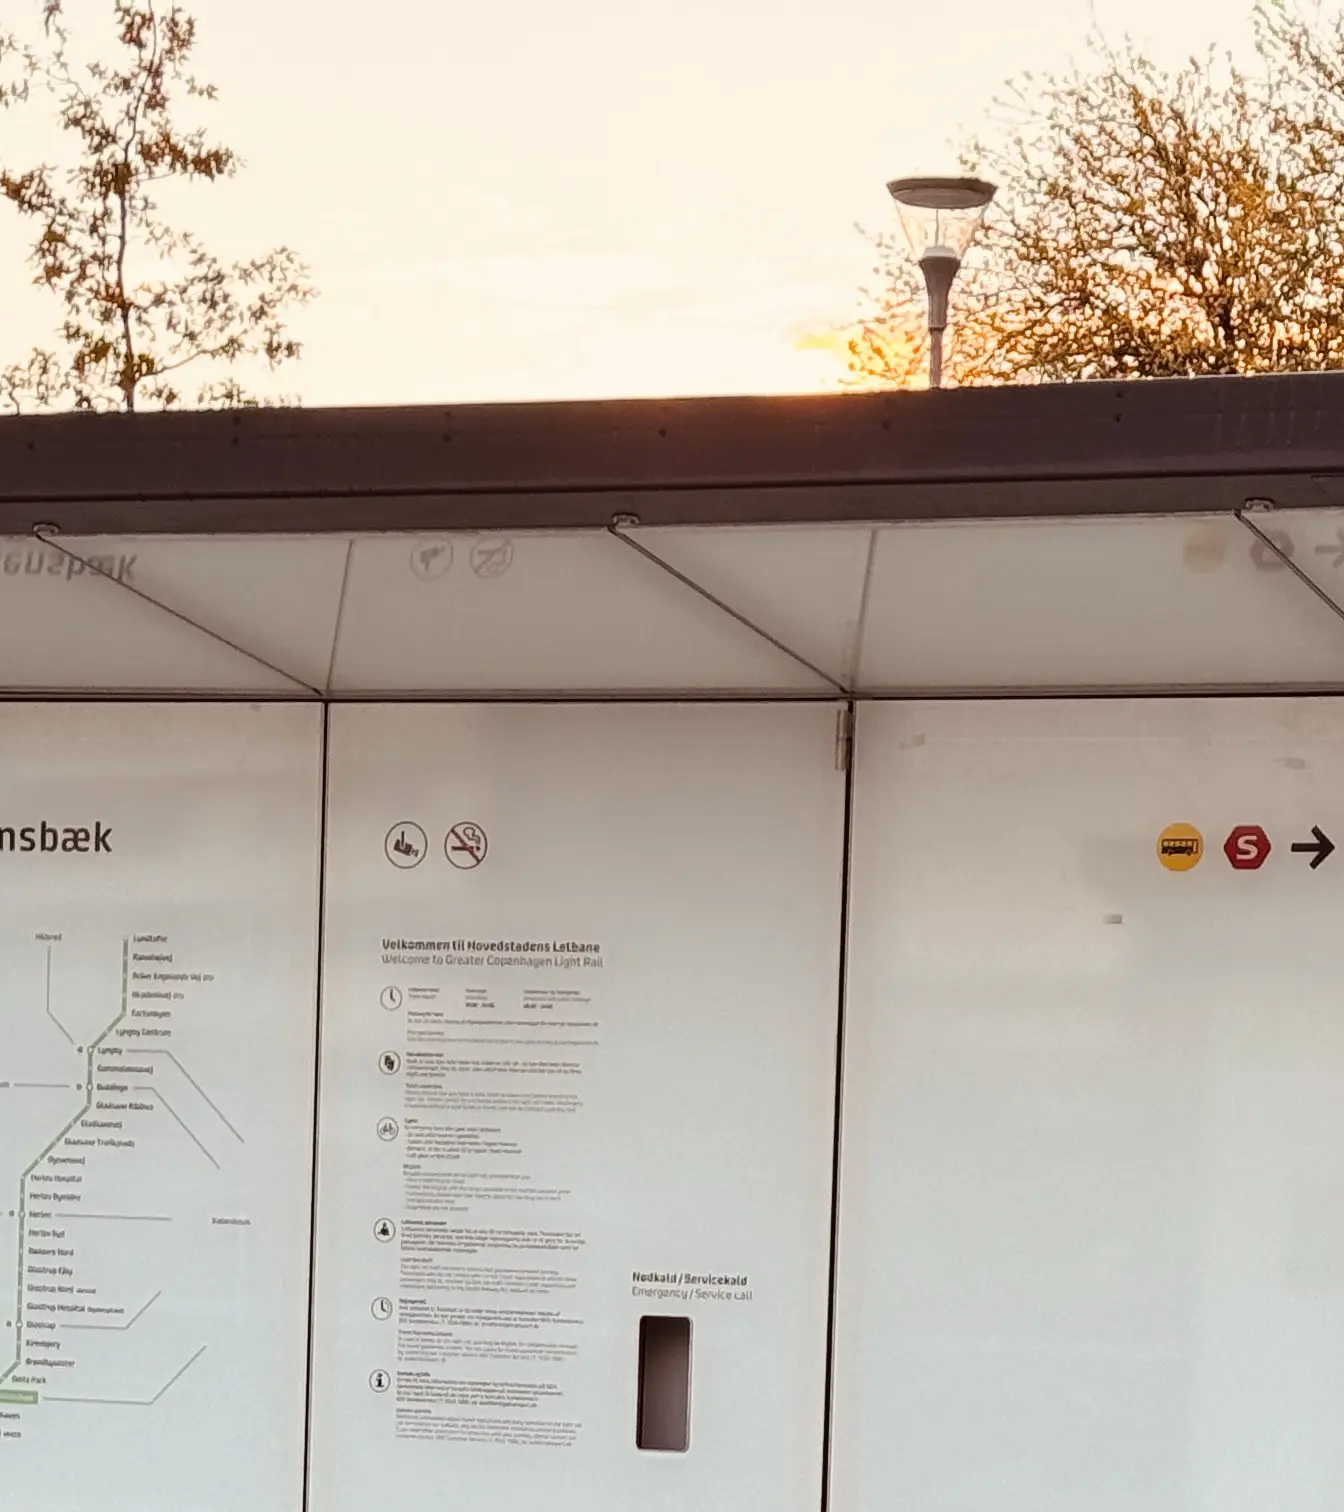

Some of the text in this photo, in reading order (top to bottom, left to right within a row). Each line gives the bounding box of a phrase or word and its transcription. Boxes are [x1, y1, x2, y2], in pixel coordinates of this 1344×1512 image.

[1236, 835, 1258, 861] S
[383, 939, 450, 951] Velkommen
[452, 940, 464, 951] til
[432, 955, 443, 965] to
[445, 954, 484, 965] Greater
[695, 1289, 732, 1300] Service
[734, 1291, 752, 1300] call
